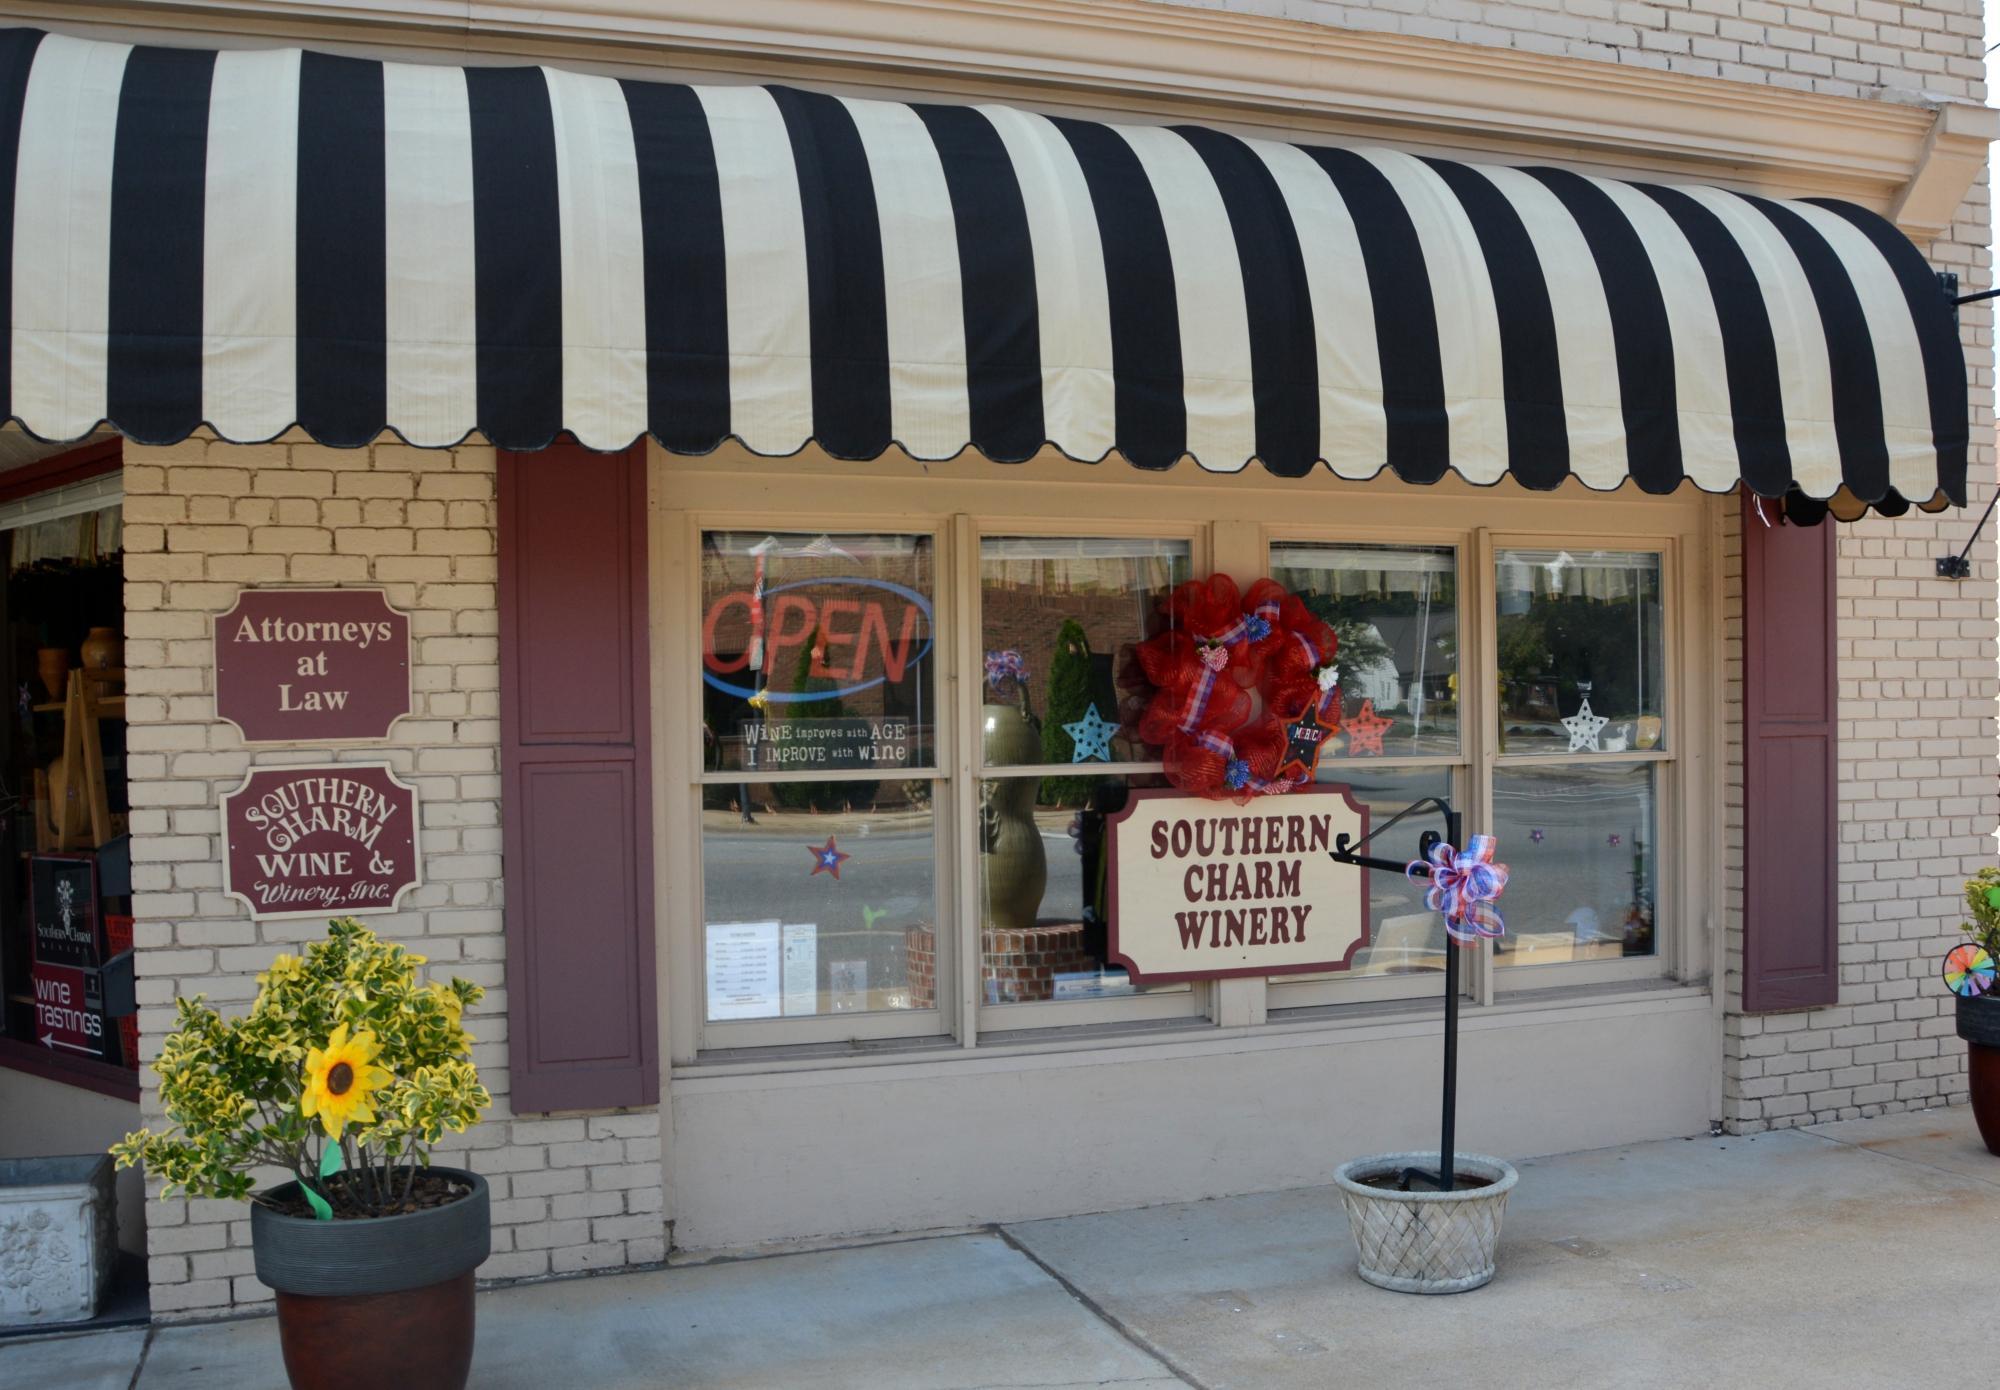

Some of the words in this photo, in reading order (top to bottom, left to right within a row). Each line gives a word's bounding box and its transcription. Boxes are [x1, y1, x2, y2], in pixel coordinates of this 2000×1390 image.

[234, 615, 391, 648] Attorneys
[703, 592, 918, 682] OPEN
[297, 651, 327, 677] at
[278, 684, 348, 711] Law
[796, 727, 843, 741] improves
[847, 728, 867, 738] with
[870, 724, 906, 740] AGE
[747, 747, 757, 766] I
[766, 747, 826, 763] IMPROVE
[832, 747, 853, 758] with
[245, 778, 397, 830] SOUTHERN
[267, 806, 382, 852] CHARM
[1151, 814, 1332, 859] SOUTHERN
[256, 852, 352, 878] WINE
[369, 851, 394, 875] &
[1184, 860, 1302, 903] CHARM
[1175, 905, 1312, 950] WINERY
